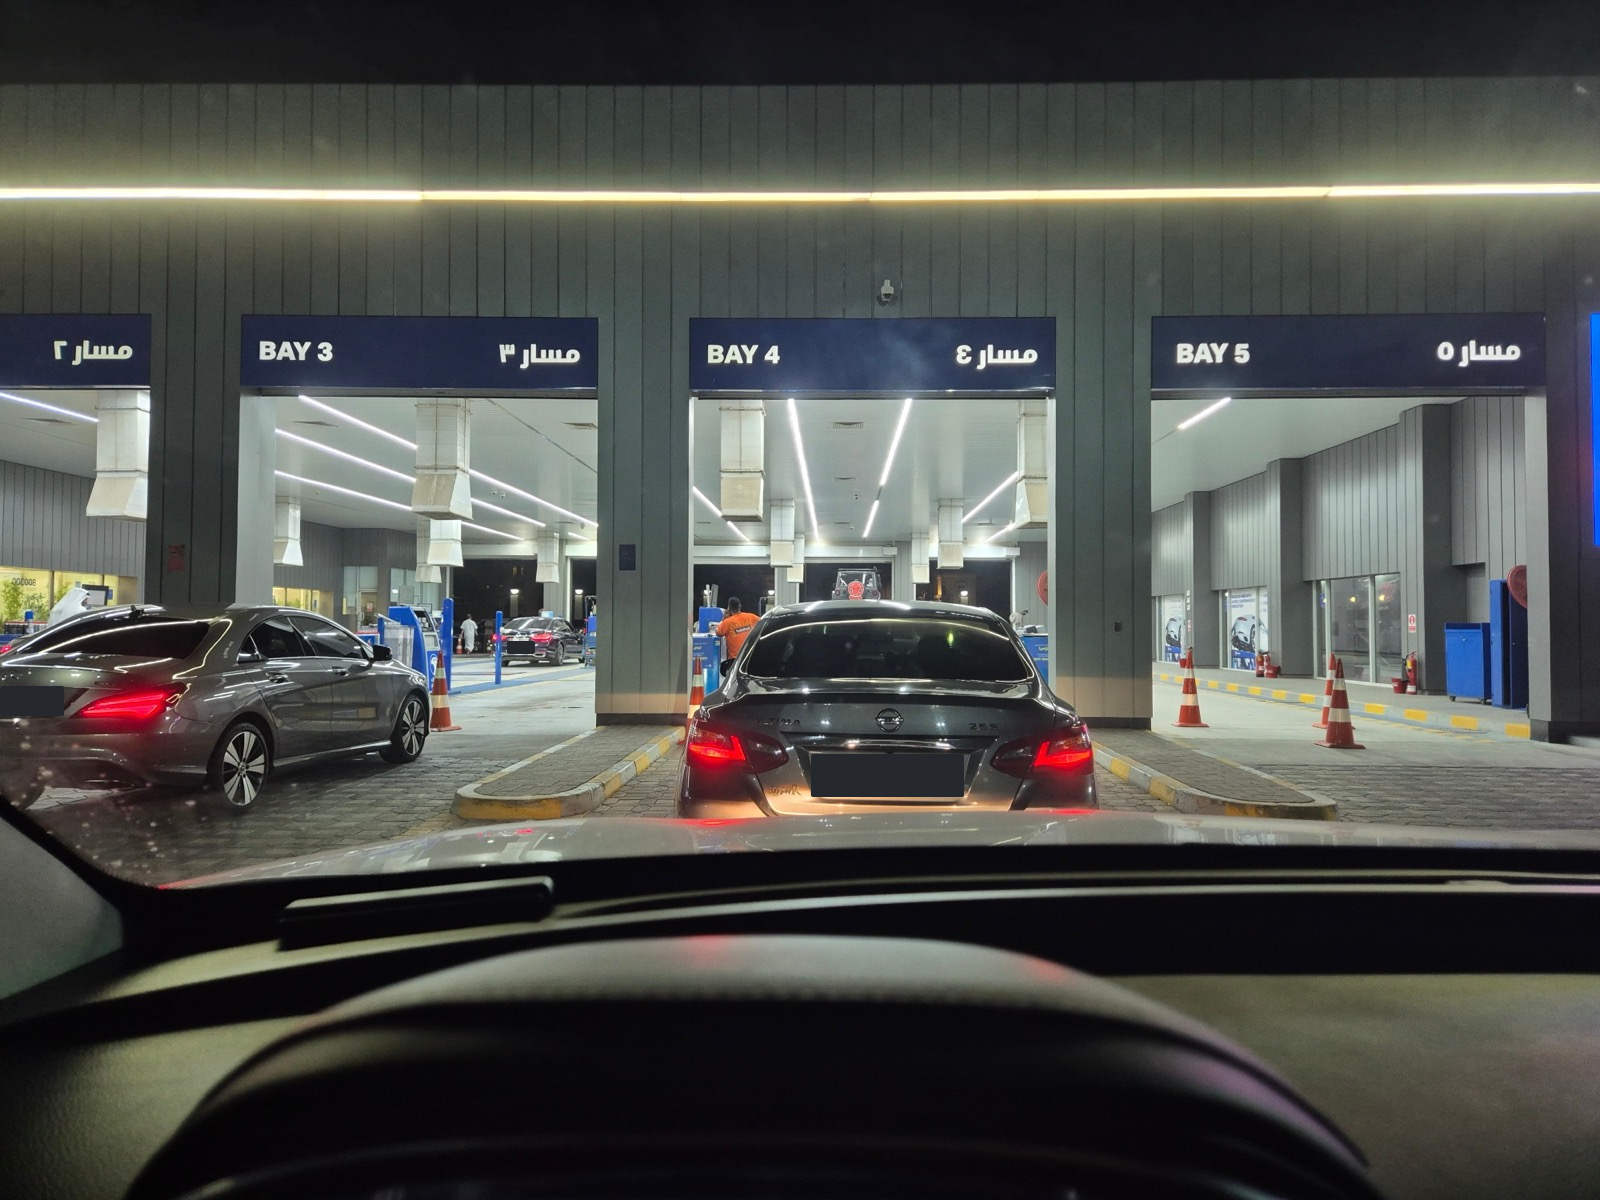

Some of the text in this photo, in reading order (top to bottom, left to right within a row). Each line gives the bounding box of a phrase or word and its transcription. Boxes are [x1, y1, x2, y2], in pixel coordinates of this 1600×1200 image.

[53, 340, 134, 366] مسار ٢
[259, 340, 334, 362] BAY 3
[498, 343, 581, 370] مسار ٣
[707, 344, 781, 365] BAY 4
[955, 344, 1038, 371] مسار ٤
[1176, 342, 1251, 364] BAY 5
[1436, 339, 1521, 368] مسار ٥
